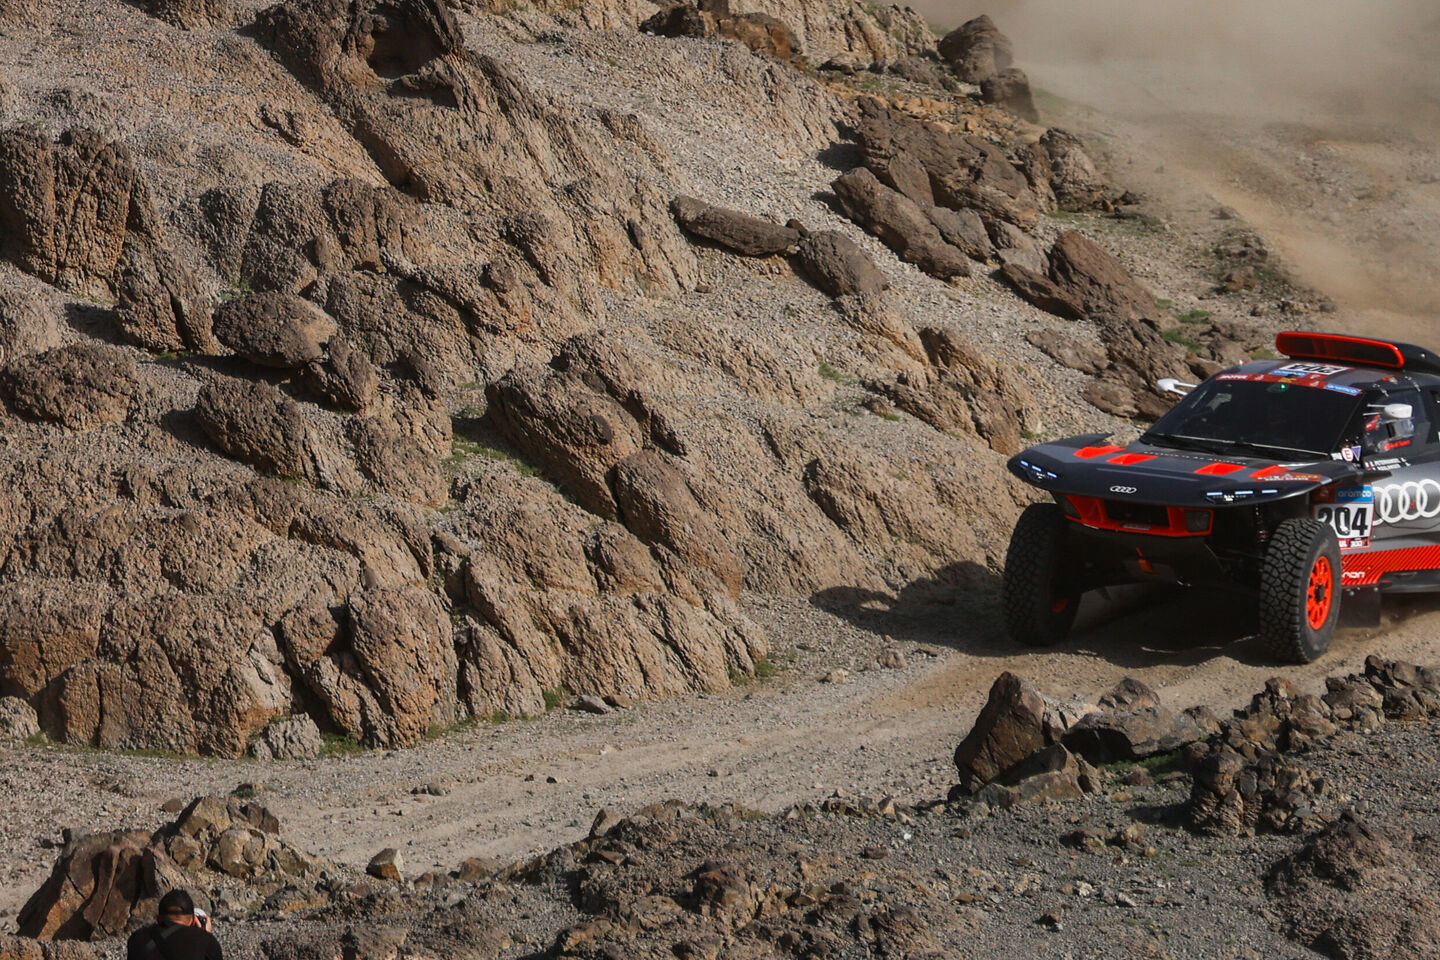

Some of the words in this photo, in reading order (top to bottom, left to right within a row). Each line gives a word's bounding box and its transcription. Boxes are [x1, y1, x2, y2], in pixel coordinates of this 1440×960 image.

[1337, 489, 1372, 498] aramco
[1317, 507, 1368, 536] 204
[1341, 571, 1366, 579] ron
